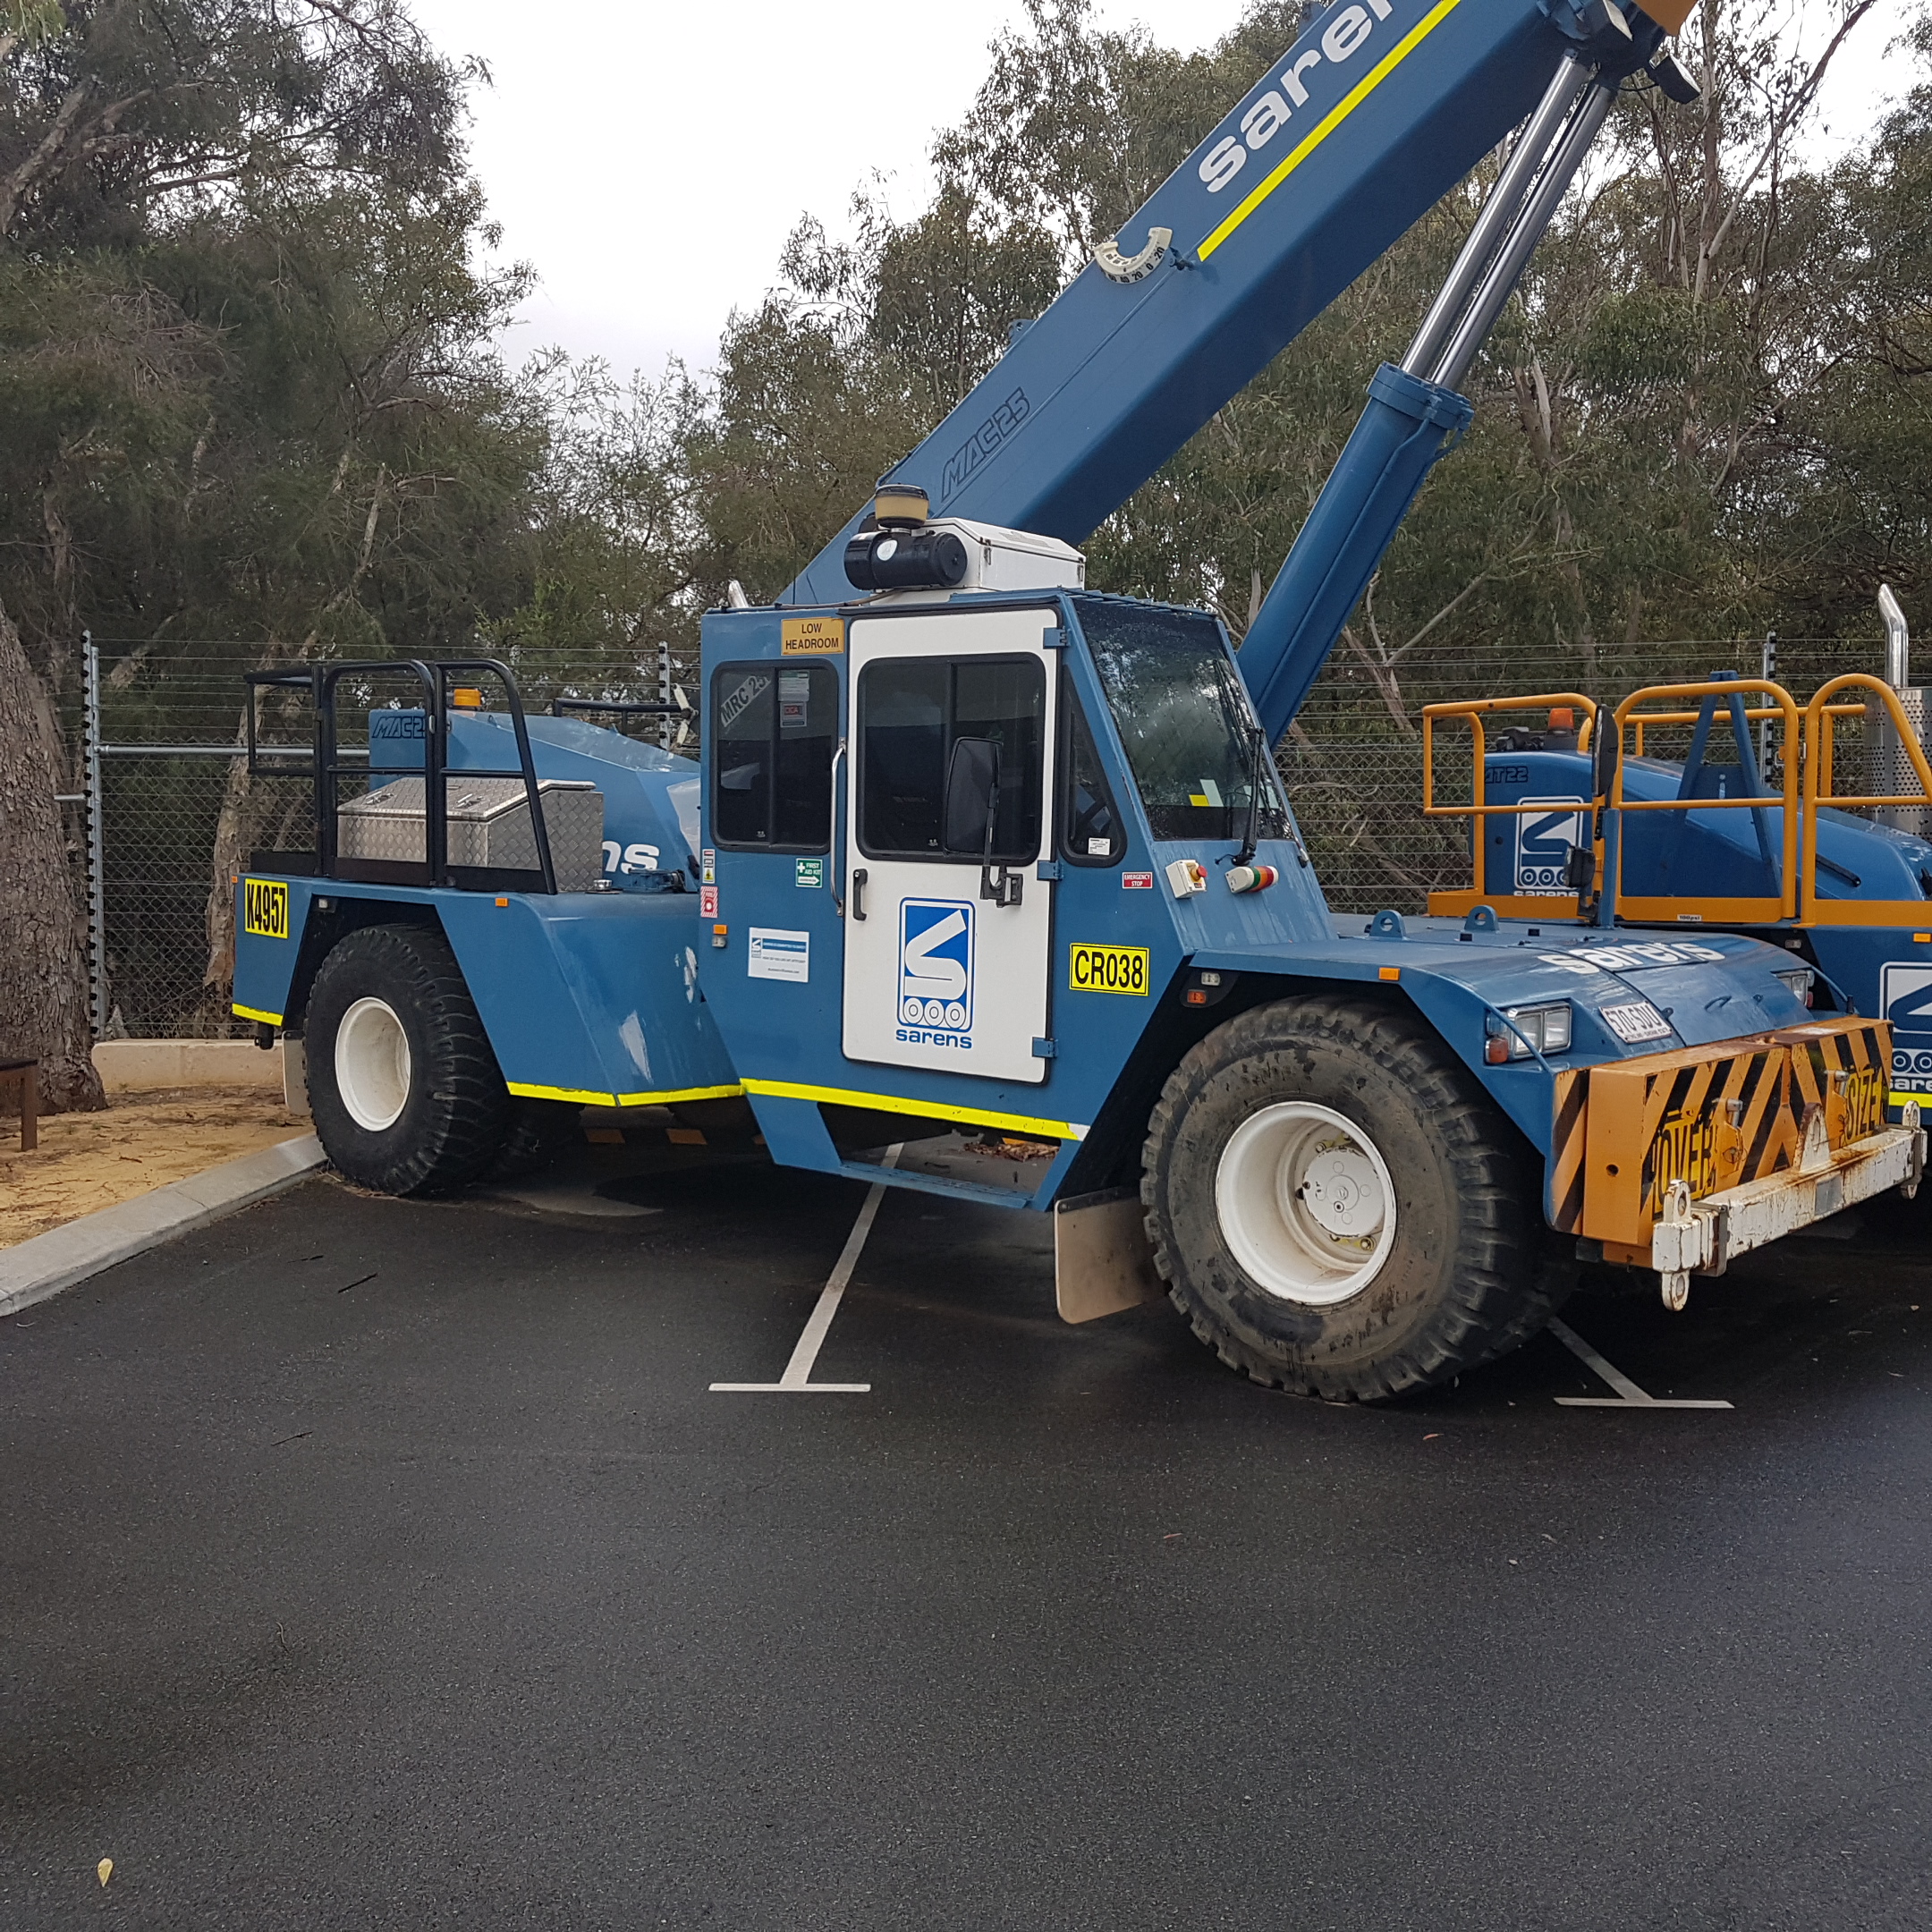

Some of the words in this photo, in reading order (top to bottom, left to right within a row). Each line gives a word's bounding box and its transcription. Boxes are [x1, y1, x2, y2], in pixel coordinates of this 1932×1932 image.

[1131, 271, 1143, 281] 20
[941, 386, 1030, 503] MAC25
[801, 623, 822, 634] LOW
[785, 637, 839, 650] HEADROOM
[722, 688, 749, 724] MRC
[371, 716, 426, 739] MAC2
[246, 884, 286, 935] K4957
[1074, 950, 1143, 988] CR038
[895, 1029, 973, 1049] sarens
[1890, 1077, 1932, 1092] ar
[1657, 1120, 1716, 1207] OVER
[1846, 1073, 1878, 1141] SIZE
